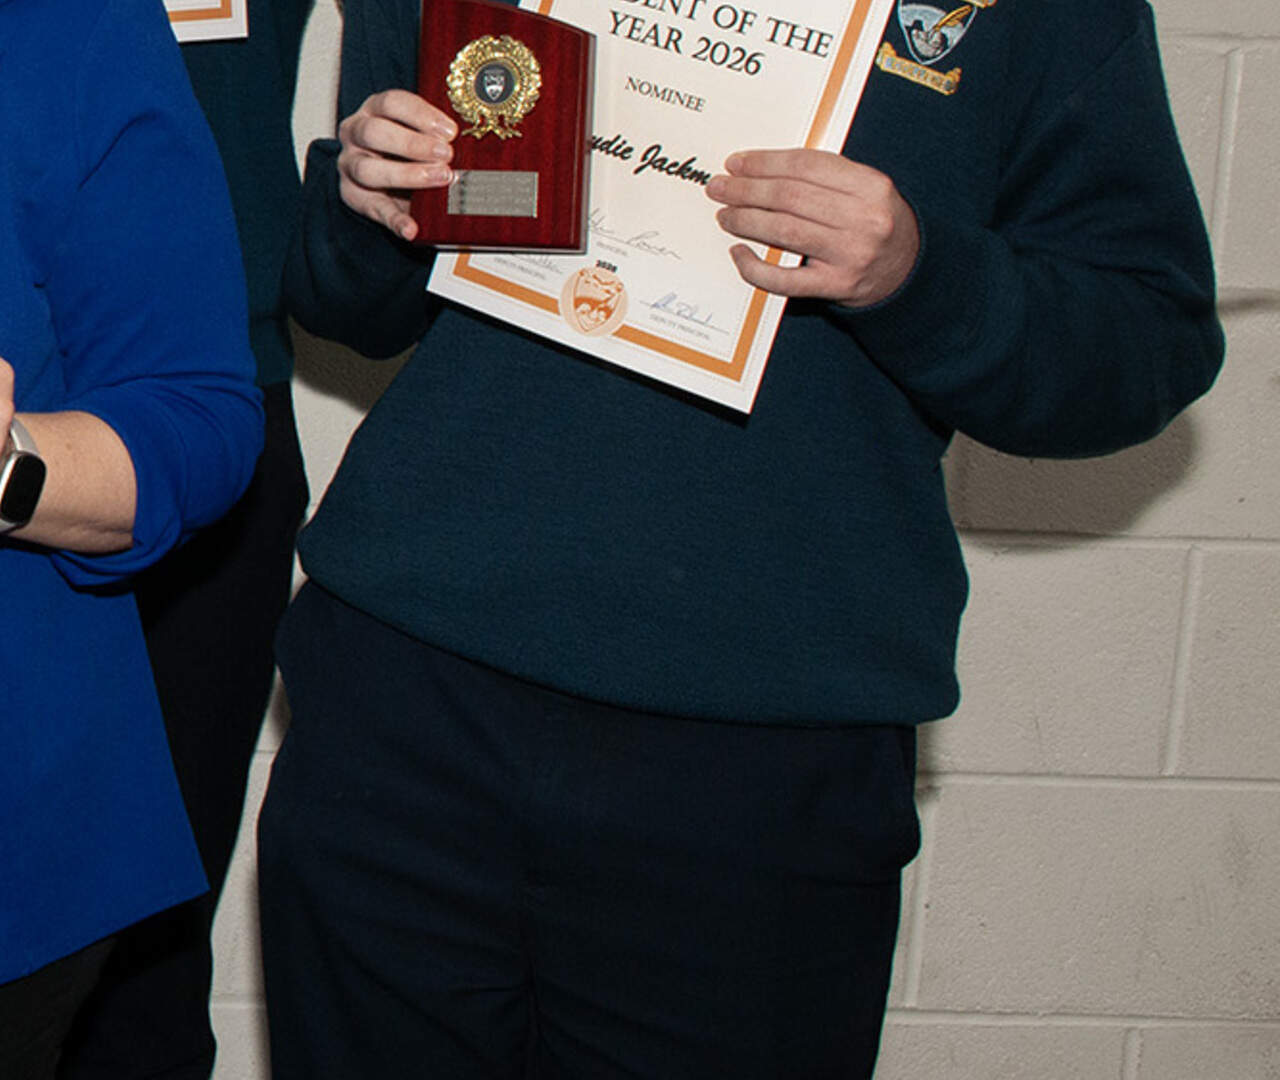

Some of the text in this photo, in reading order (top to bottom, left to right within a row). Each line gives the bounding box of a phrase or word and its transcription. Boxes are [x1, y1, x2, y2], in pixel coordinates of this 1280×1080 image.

[607, 9, 767, 77] YEAR 2026
[711, 3, 759, 36] OF
[765, 16, 835, 59] THE
[624, 75, 707, 113] NOMINEE
